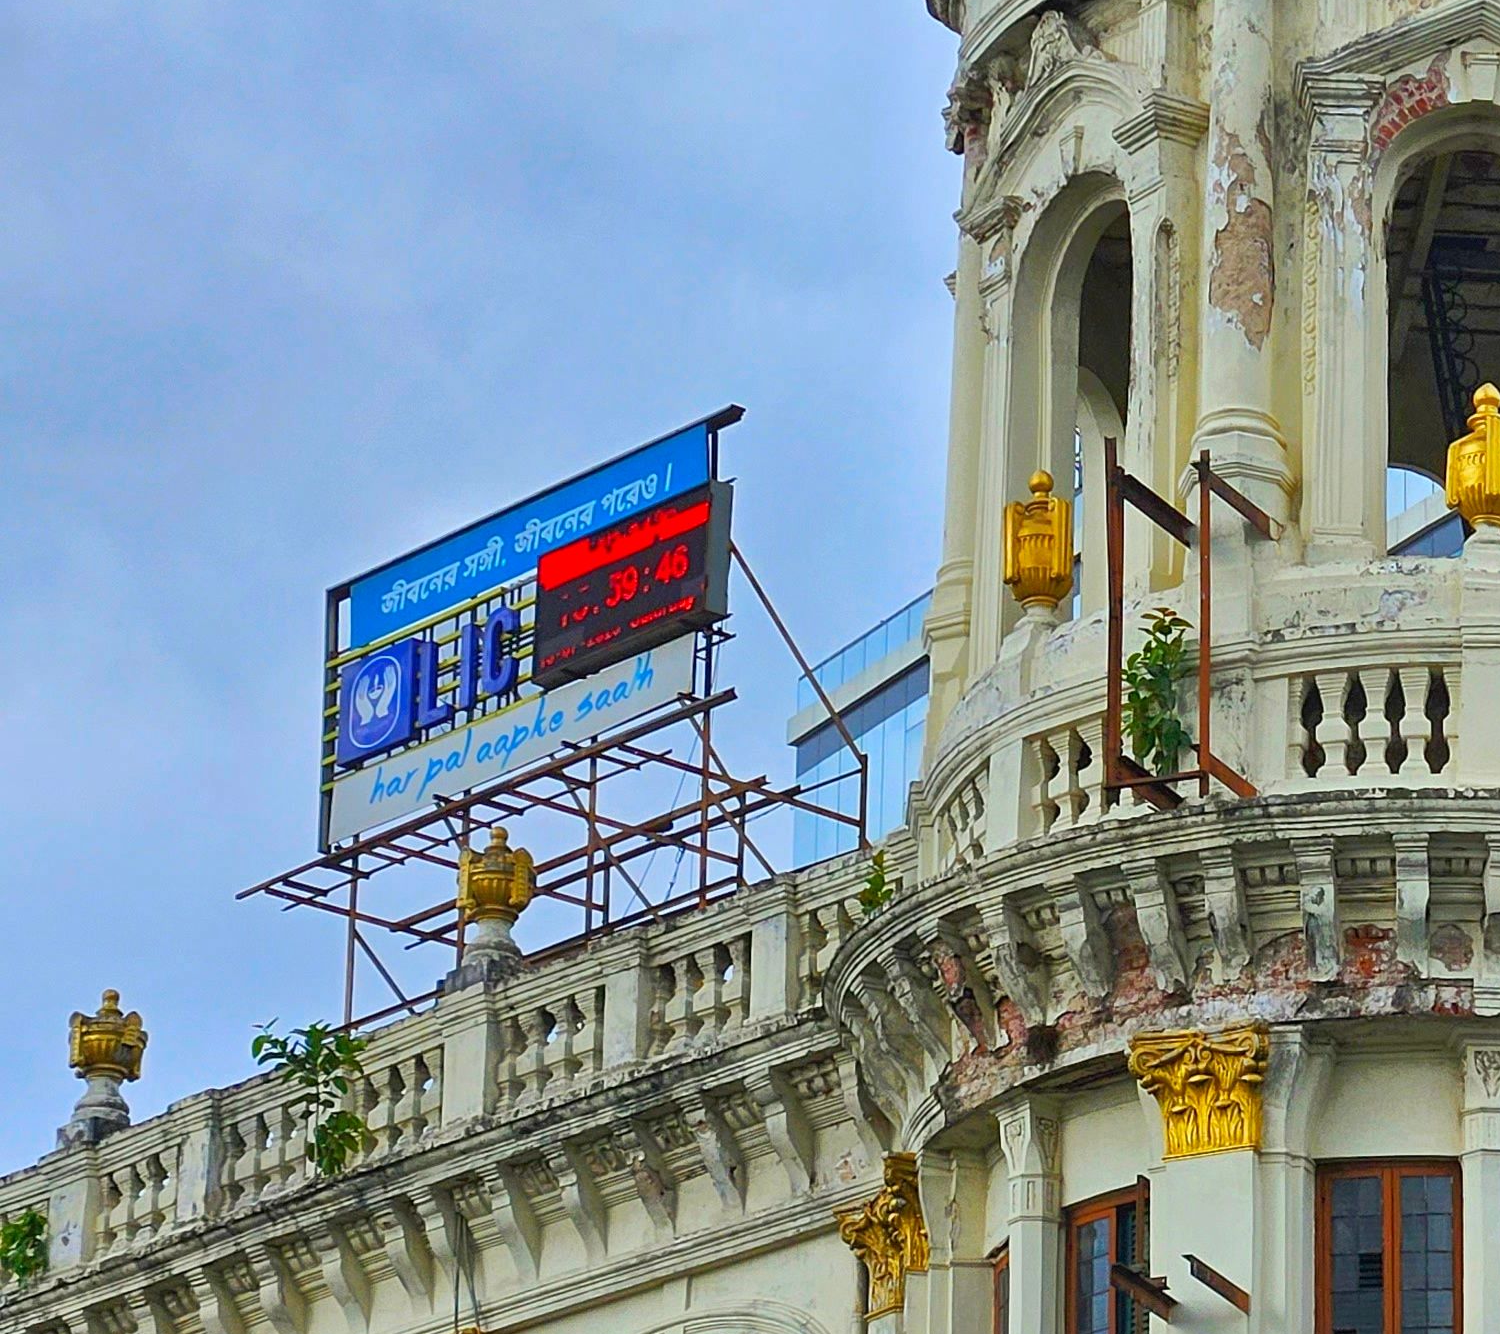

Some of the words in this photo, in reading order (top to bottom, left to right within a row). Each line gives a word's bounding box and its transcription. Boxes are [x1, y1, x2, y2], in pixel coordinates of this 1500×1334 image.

[381, 561, 461, 614] জীবনের
[514, 499, 597, 554] জীবনের
[369, 766, 418, 804] har
[416, 727, 473, 803] pal
[476, 695, 565, 770] aapke
[574, 650, 655, 723] saath
[417, 608, 521, 728] LIC
